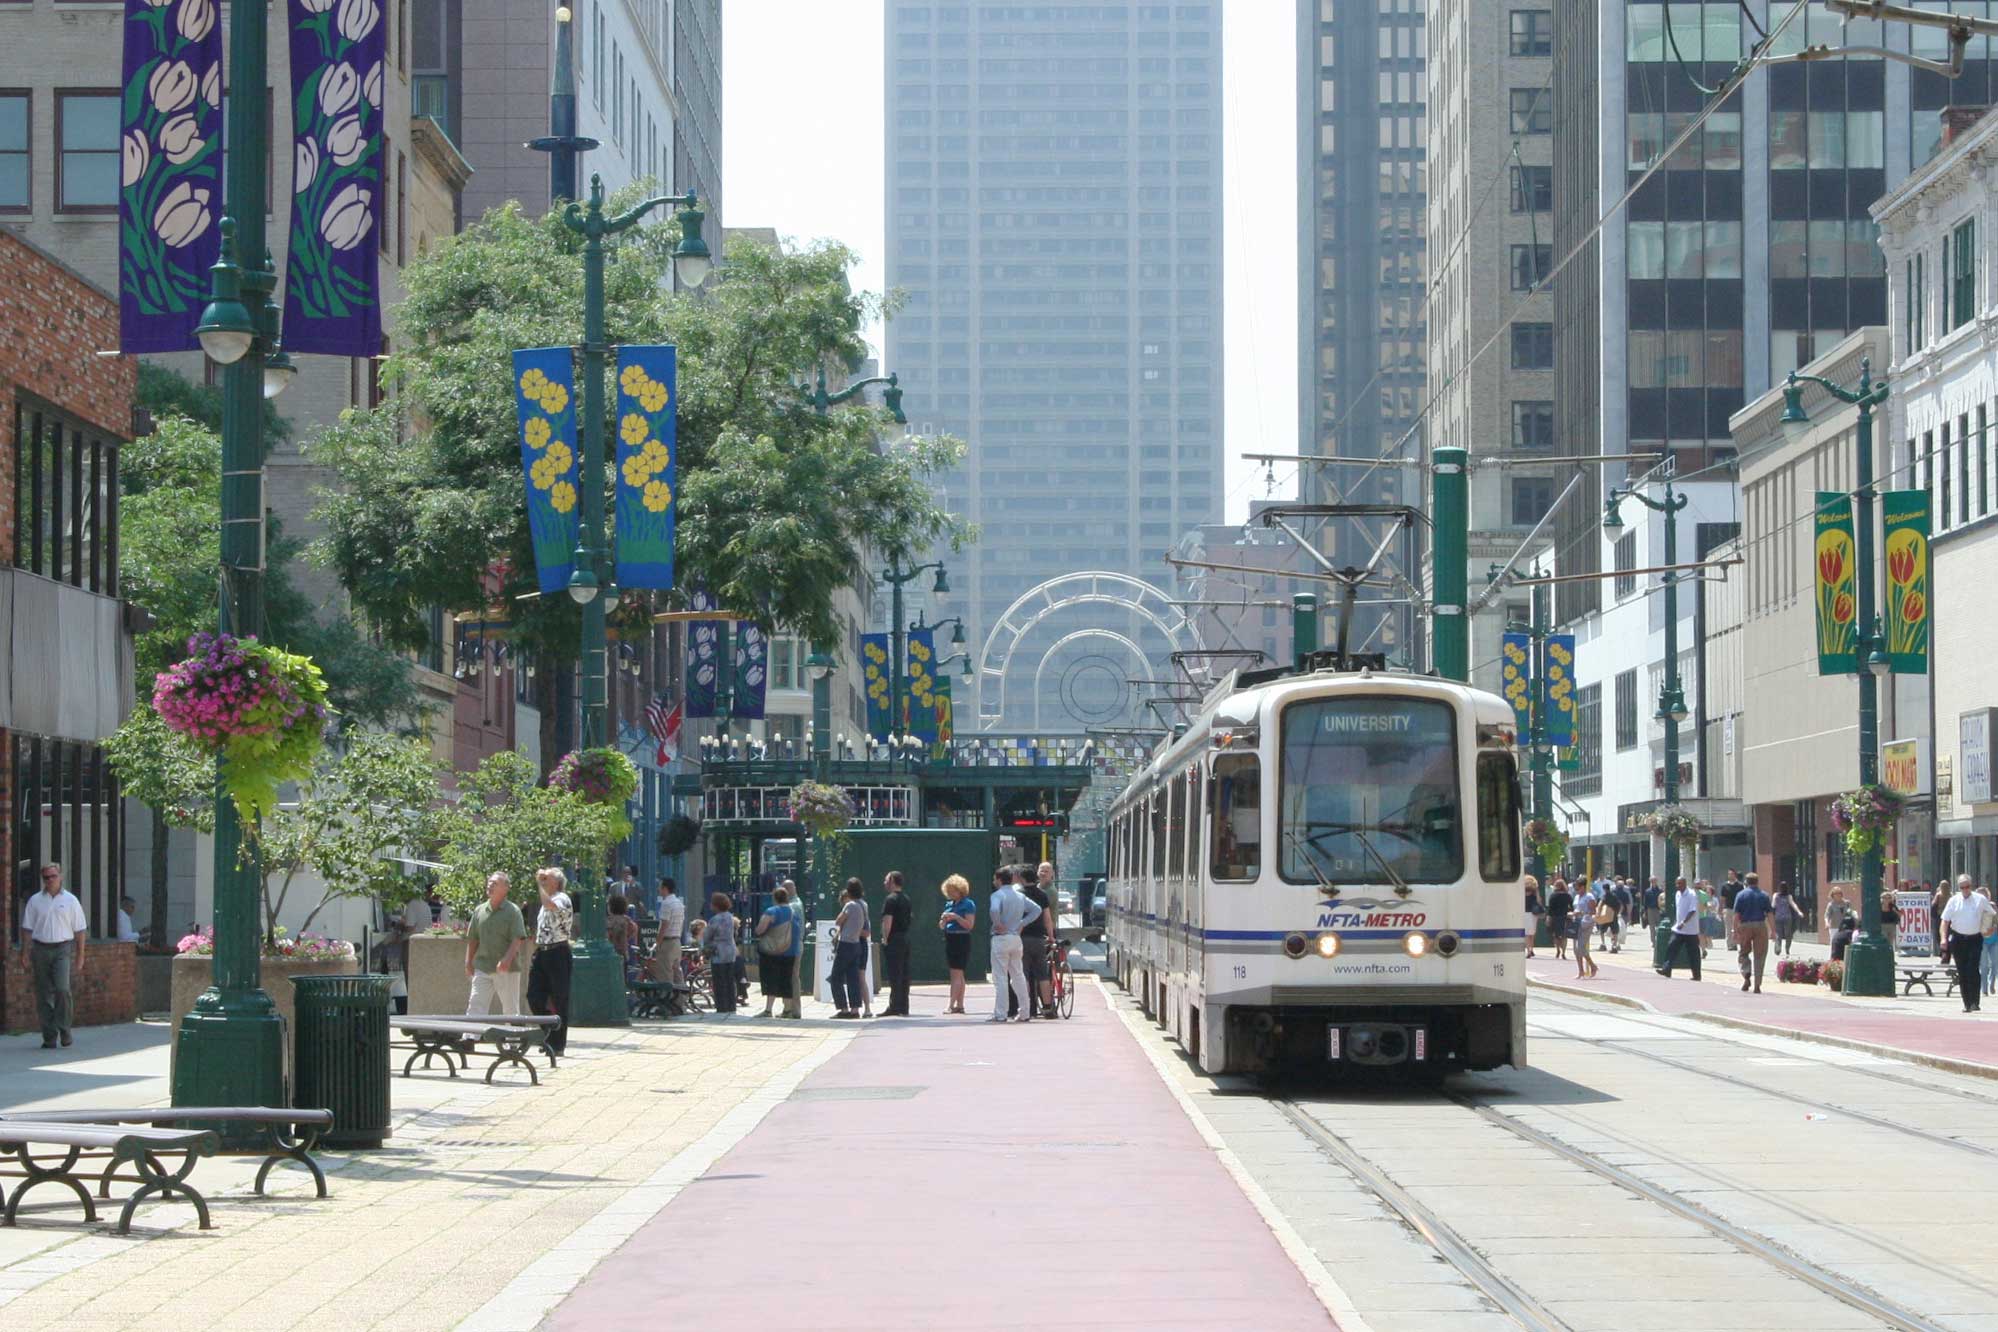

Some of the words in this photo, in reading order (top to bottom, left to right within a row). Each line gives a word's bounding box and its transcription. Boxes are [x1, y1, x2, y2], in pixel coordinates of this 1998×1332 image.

[1324, 715, 1410, 732] UNIVERSITY
[1317, 913, 1426, 928] NFTA-METRO
[1898, 907, 1929, 933] OPEN
[1898, 935, 1930, 943] 7-DAYS
[1233, 965, 1246, 979] 118
[1334, 963, 1411, 974] www.nfta.com
[1493, 963, 1504, 977] 118
